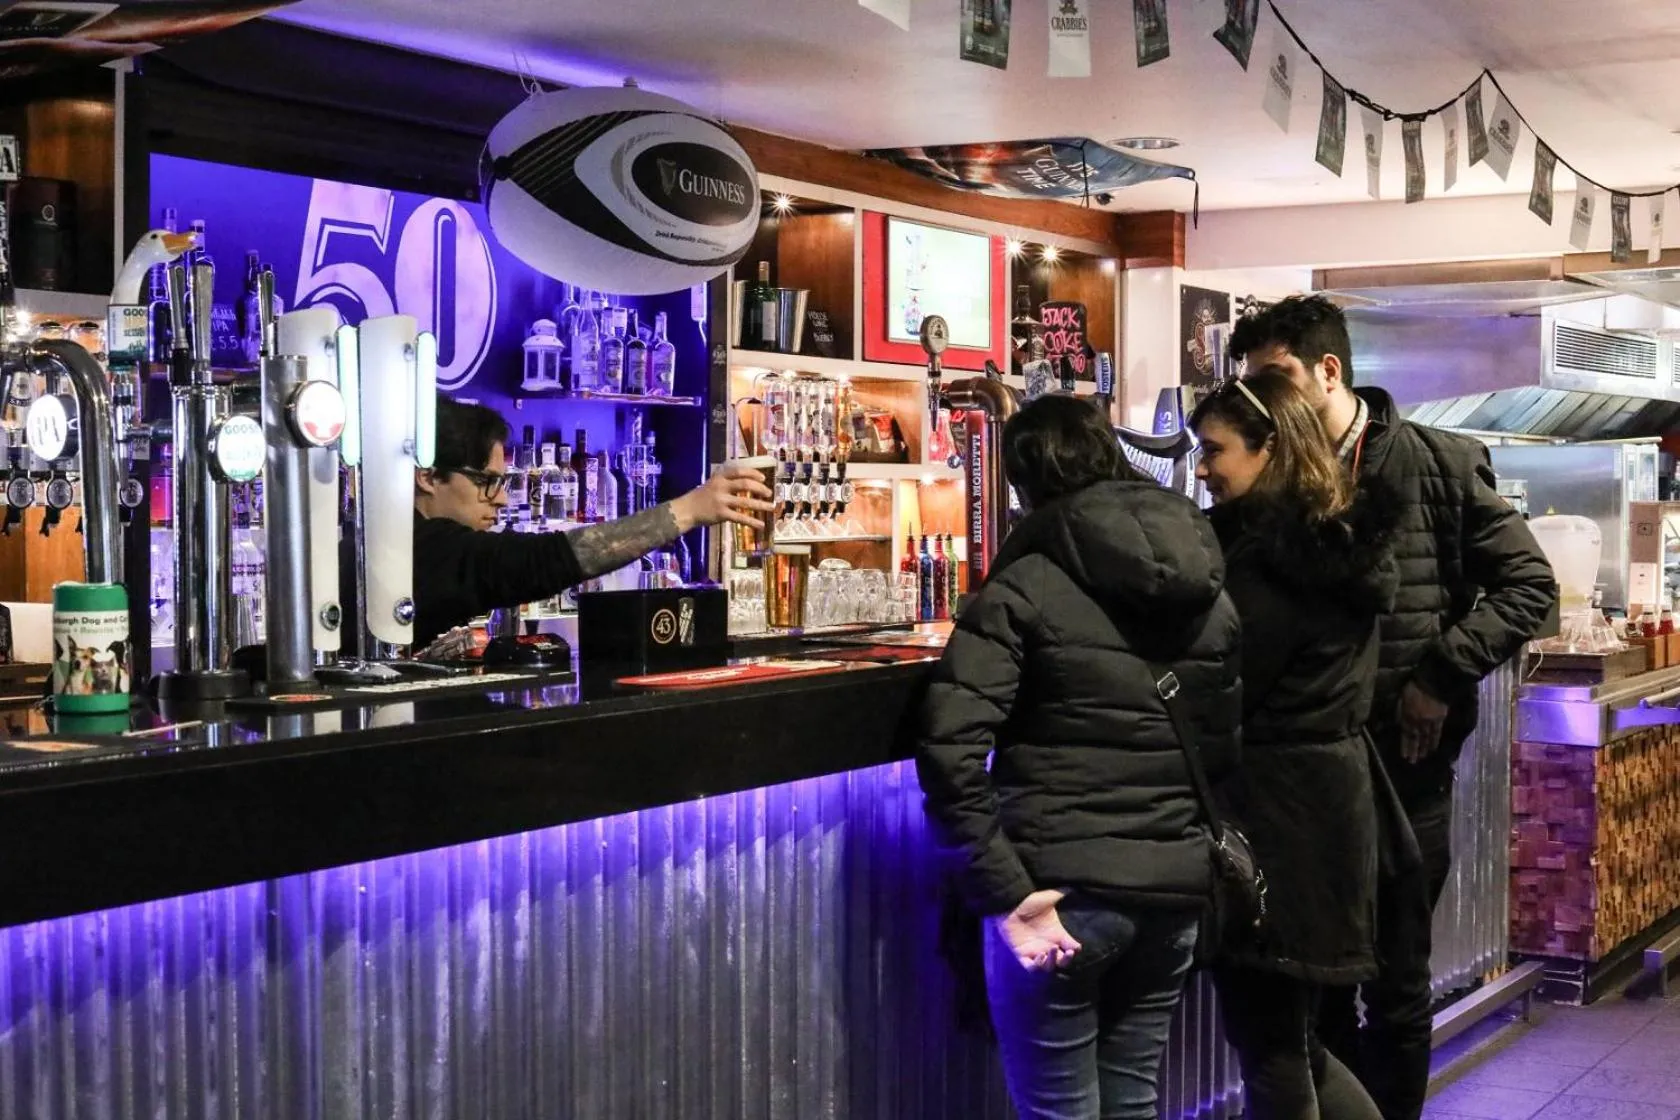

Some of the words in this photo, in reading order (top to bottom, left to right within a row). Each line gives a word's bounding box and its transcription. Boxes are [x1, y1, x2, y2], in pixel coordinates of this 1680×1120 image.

[679, 168, 745, 205] GUINNESS
[1016, 167, 1057, 190] TIME
[1043, 307, 1080, 327] JACK
[1044, 329, 1083, 353] COKE
[972, 434, 983, 497] MORETTI
[972, 500, 983, 544] BIRRA
[656, 617, 672, 635] 43
